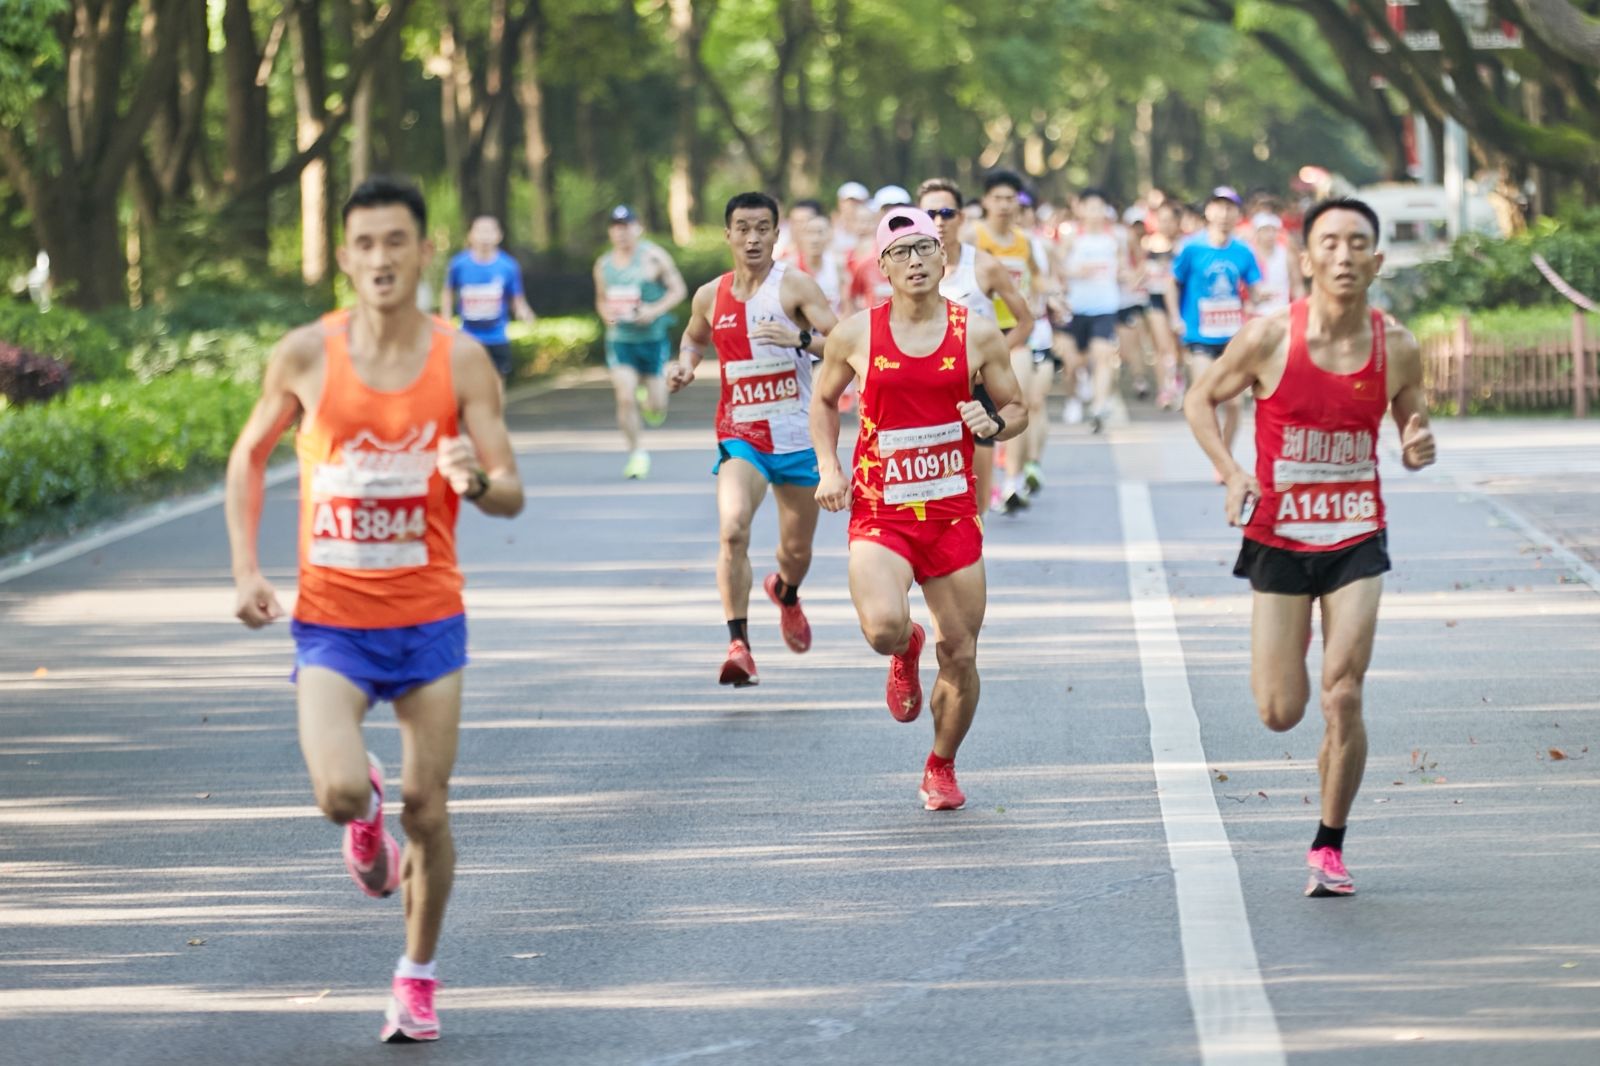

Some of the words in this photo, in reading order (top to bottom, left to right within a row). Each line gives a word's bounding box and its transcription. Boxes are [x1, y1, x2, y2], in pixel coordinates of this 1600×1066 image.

[732, 378, 798, 405] A14149
[884, 449, 964, 483] A10910
[312, 502, 427, 541] A13844
[1277, 491, 1376, 521] A14166
